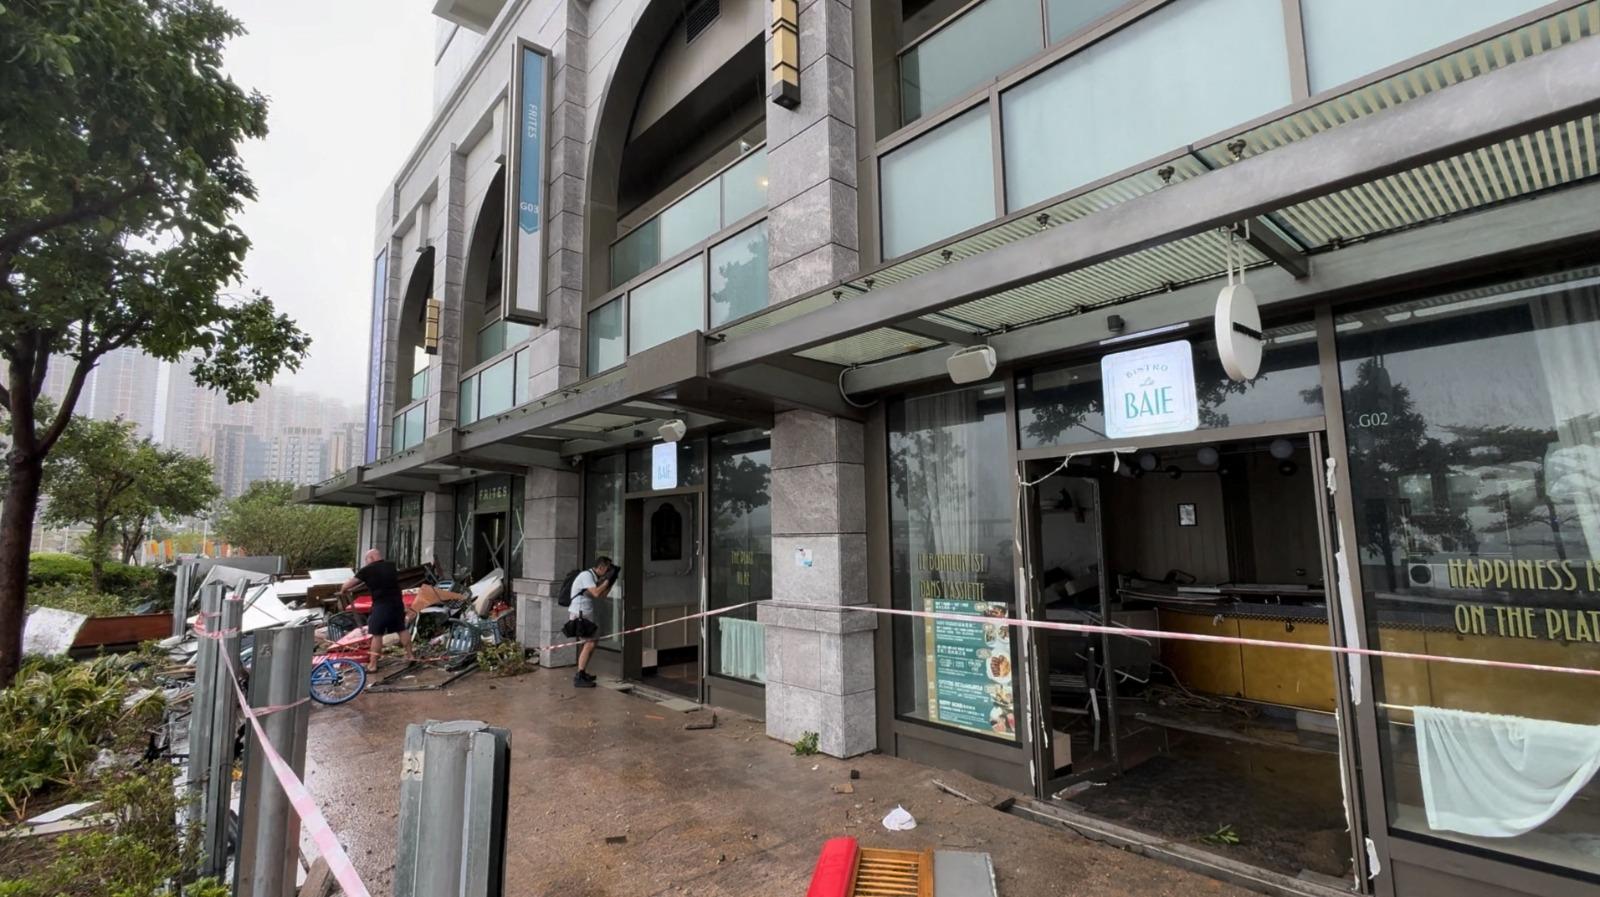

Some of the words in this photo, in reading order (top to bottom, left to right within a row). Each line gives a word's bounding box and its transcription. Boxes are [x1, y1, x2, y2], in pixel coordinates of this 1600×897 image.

[528, 104, 538, 139] FRITES
[519, 202, 539, 214] G03
[1124, 386, 1174, 419] BAIE
[1359, 412, 1389, 428] G02
[479, 486, 507, 500] FRITES
[1447, 558, 1577, 591] HAPPINESS
[1455, 603, 1487, 635] ON
[1493, 606, 1537, 639] THE
